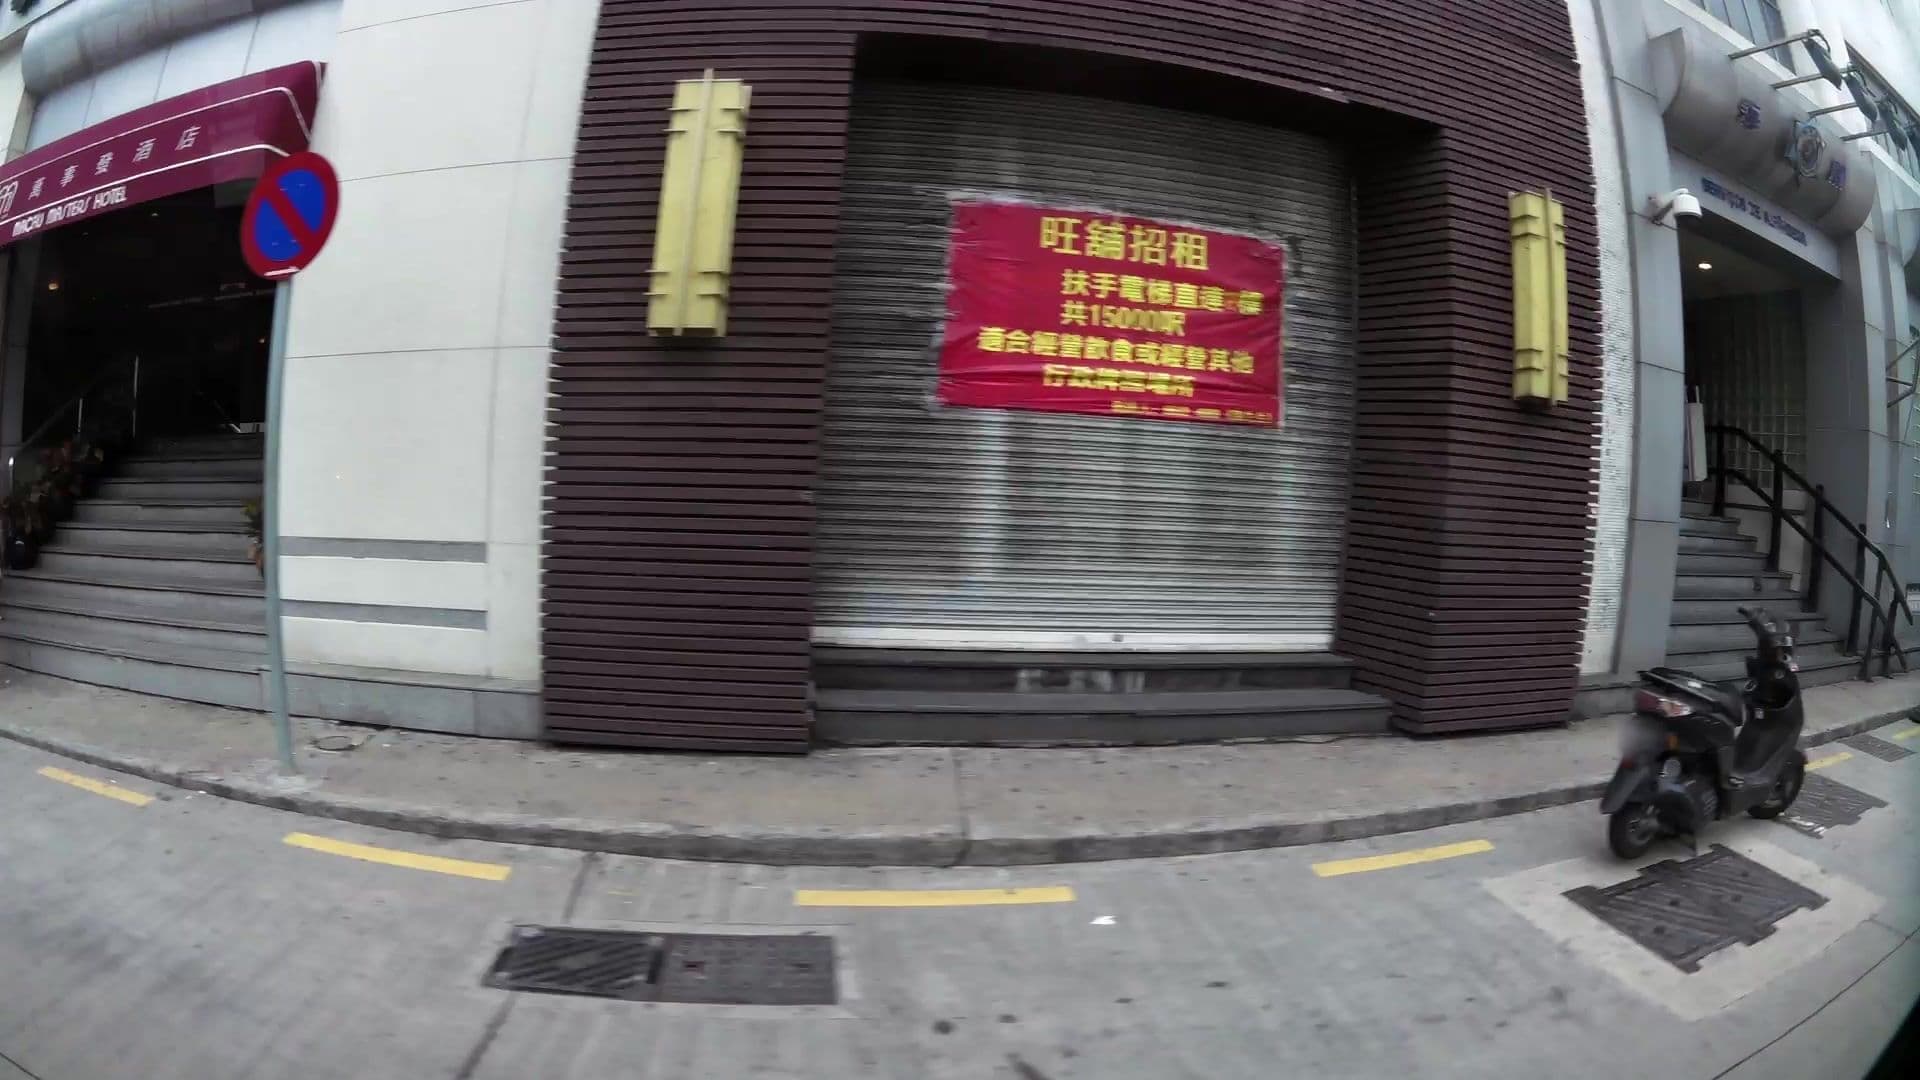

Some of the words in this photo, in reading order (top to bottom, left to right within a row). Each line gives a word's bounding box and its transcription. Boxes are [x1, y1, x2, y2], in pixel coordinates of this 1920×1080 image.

[93, 186, 128, 211] HOTEL
[1061, 269, 1265, 316] 扶手電梯直達樓
